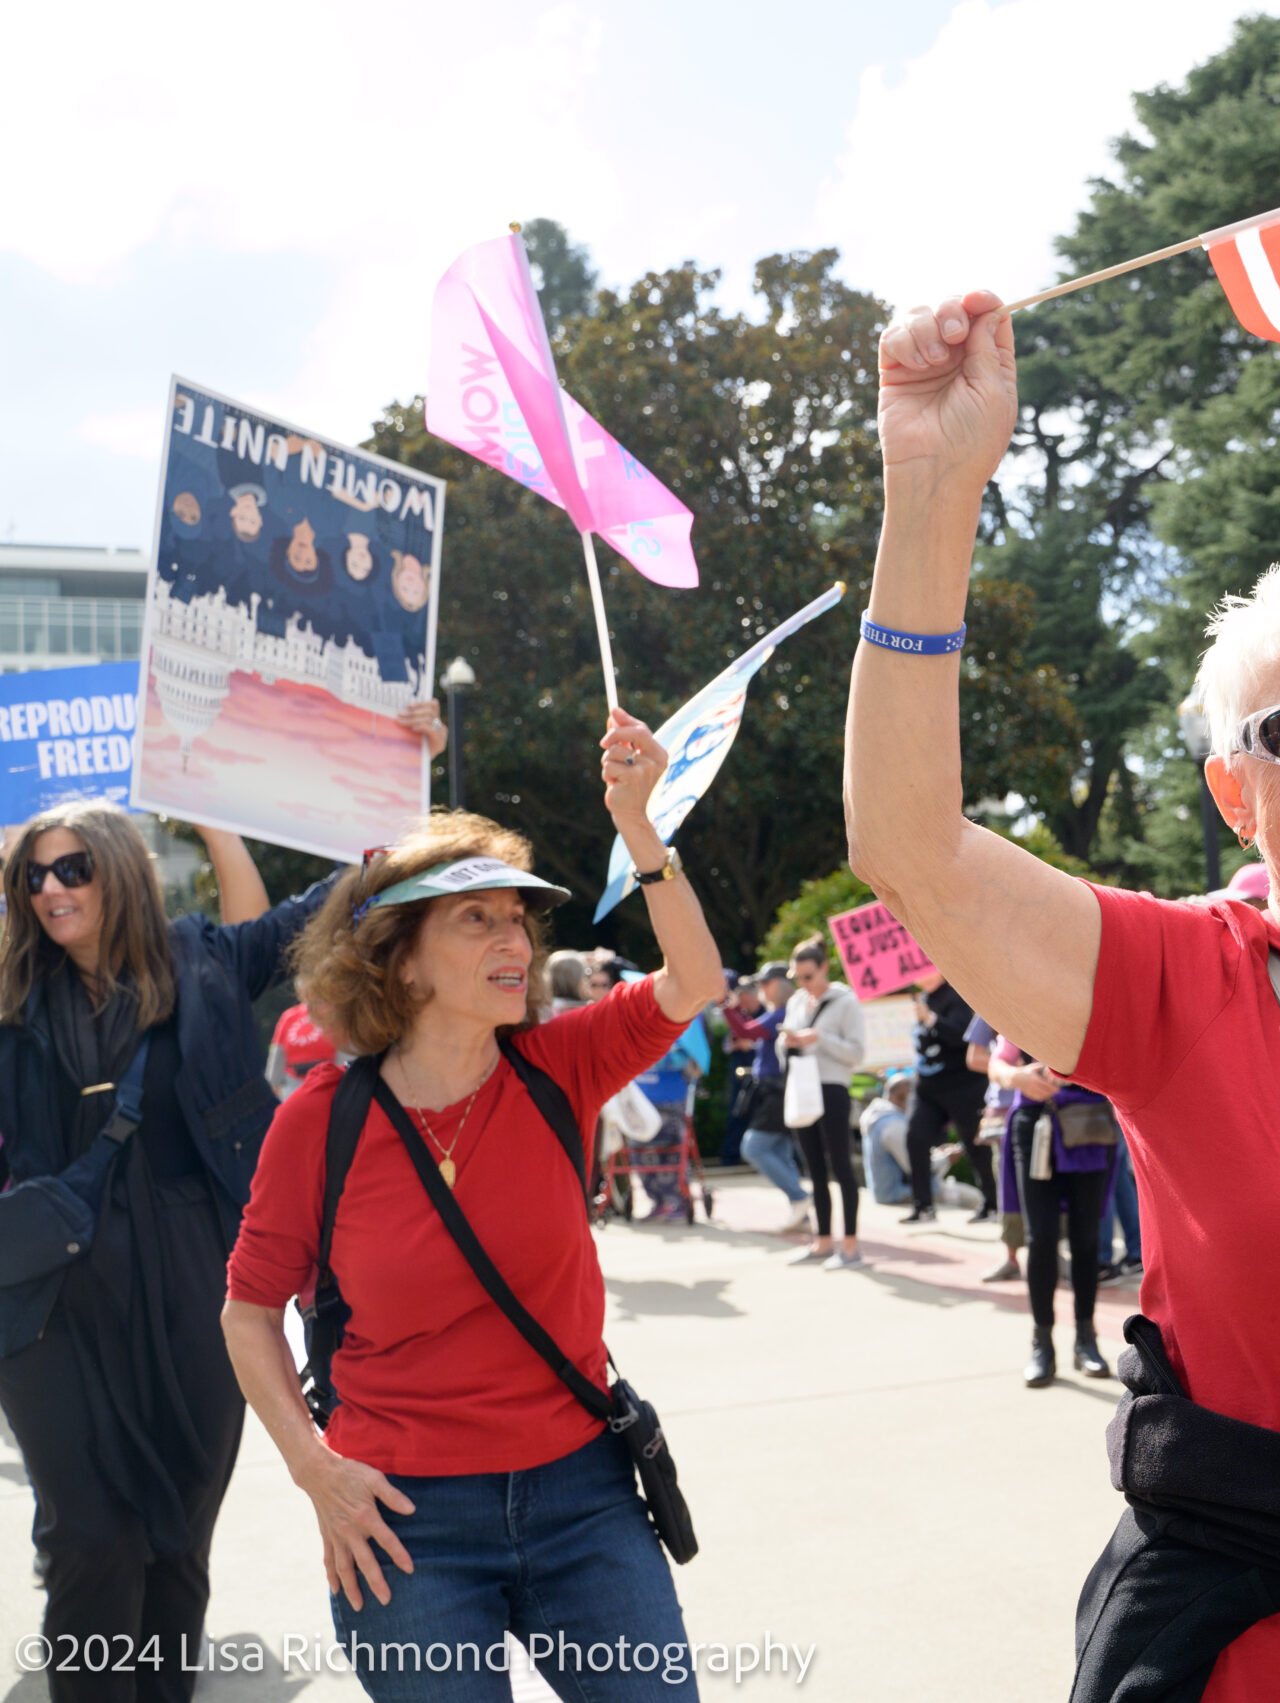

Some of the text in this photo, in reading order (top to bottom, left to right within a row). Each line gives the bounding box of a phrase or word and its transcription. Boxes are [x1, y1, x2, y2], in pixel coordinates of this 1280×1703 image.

[174, 393, 289, 472] UNITE
[300, 443, 435, 532] WOMEN
[890, 634, 923, 651] FOR
[0, 693, 140, 742] REPRODU
[37, 734, 136, 779] FREED
[861, 965, 879, 990] 4
